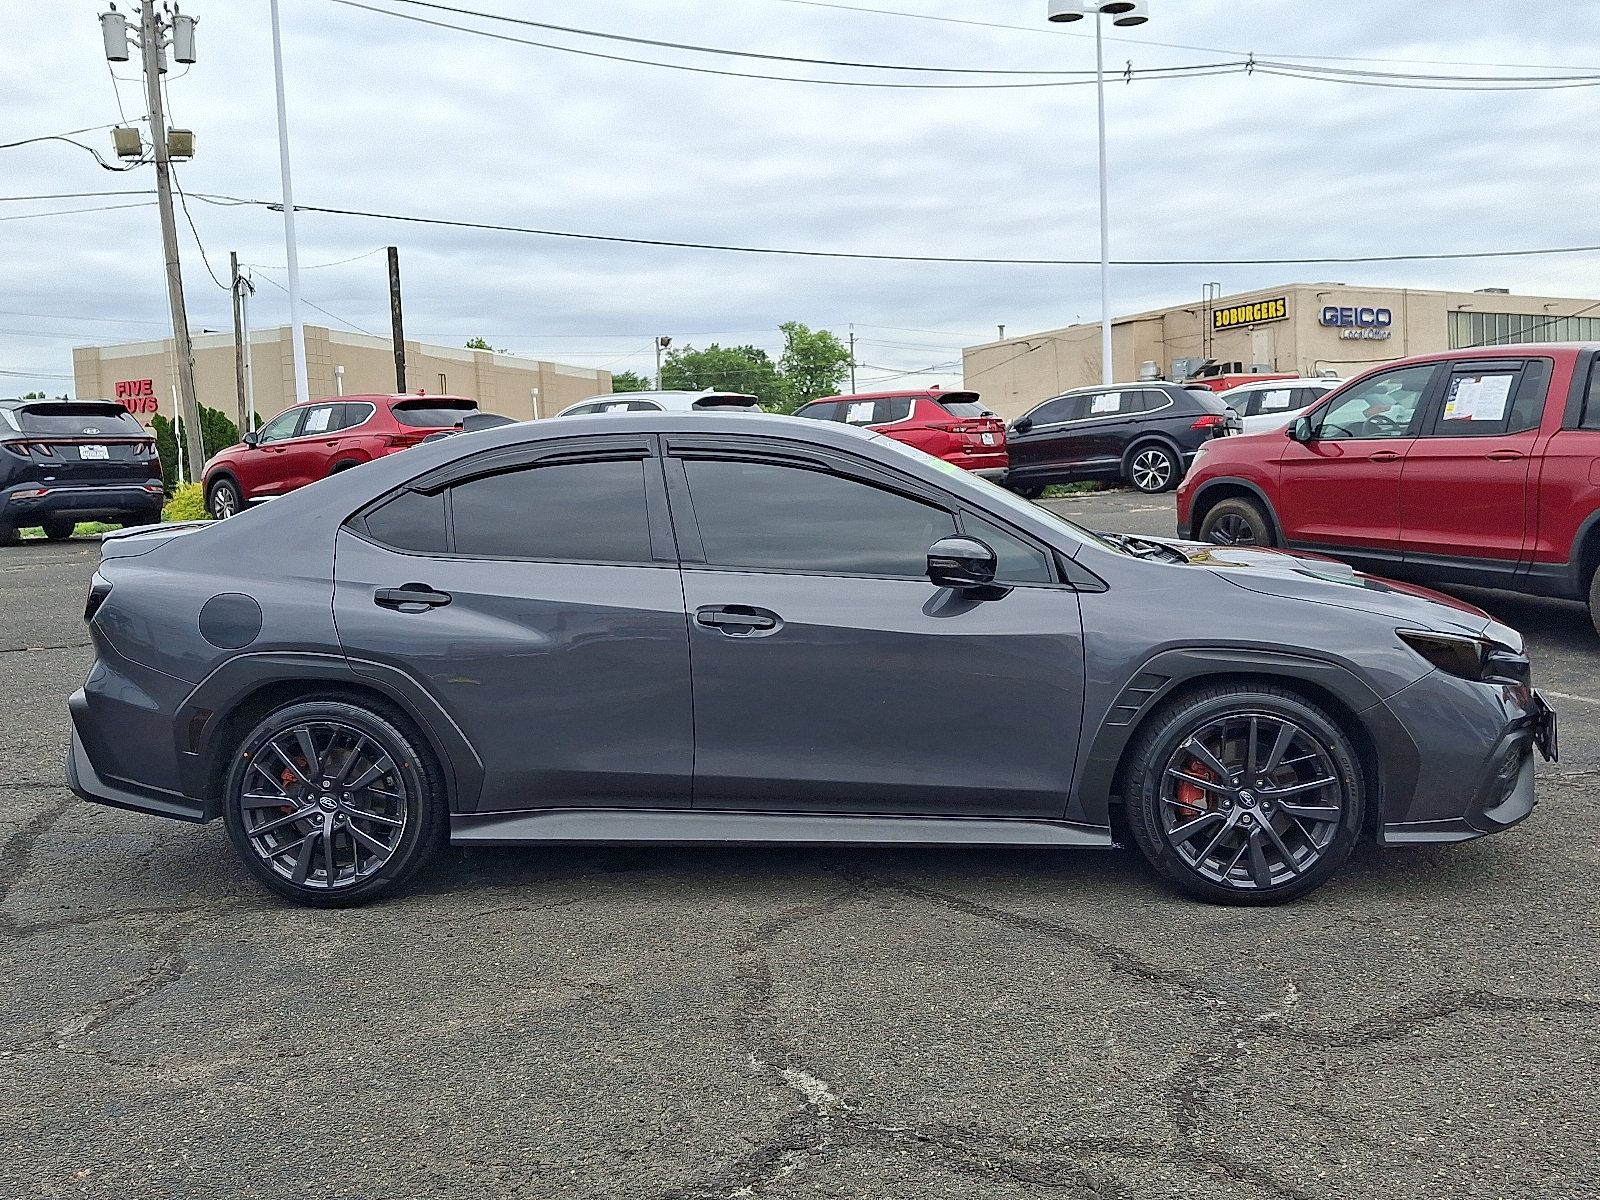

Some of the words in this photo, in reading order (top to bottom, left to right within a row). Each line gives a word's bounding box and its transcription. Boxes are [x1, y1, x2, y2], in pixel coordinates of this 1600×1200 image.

[1320, 306, 1392, 327] GEICO
[1340, 328, 1368, 340] Local
[1368, 327, 1392, 340] Office
[115, 380, 153, 397] FIVE
